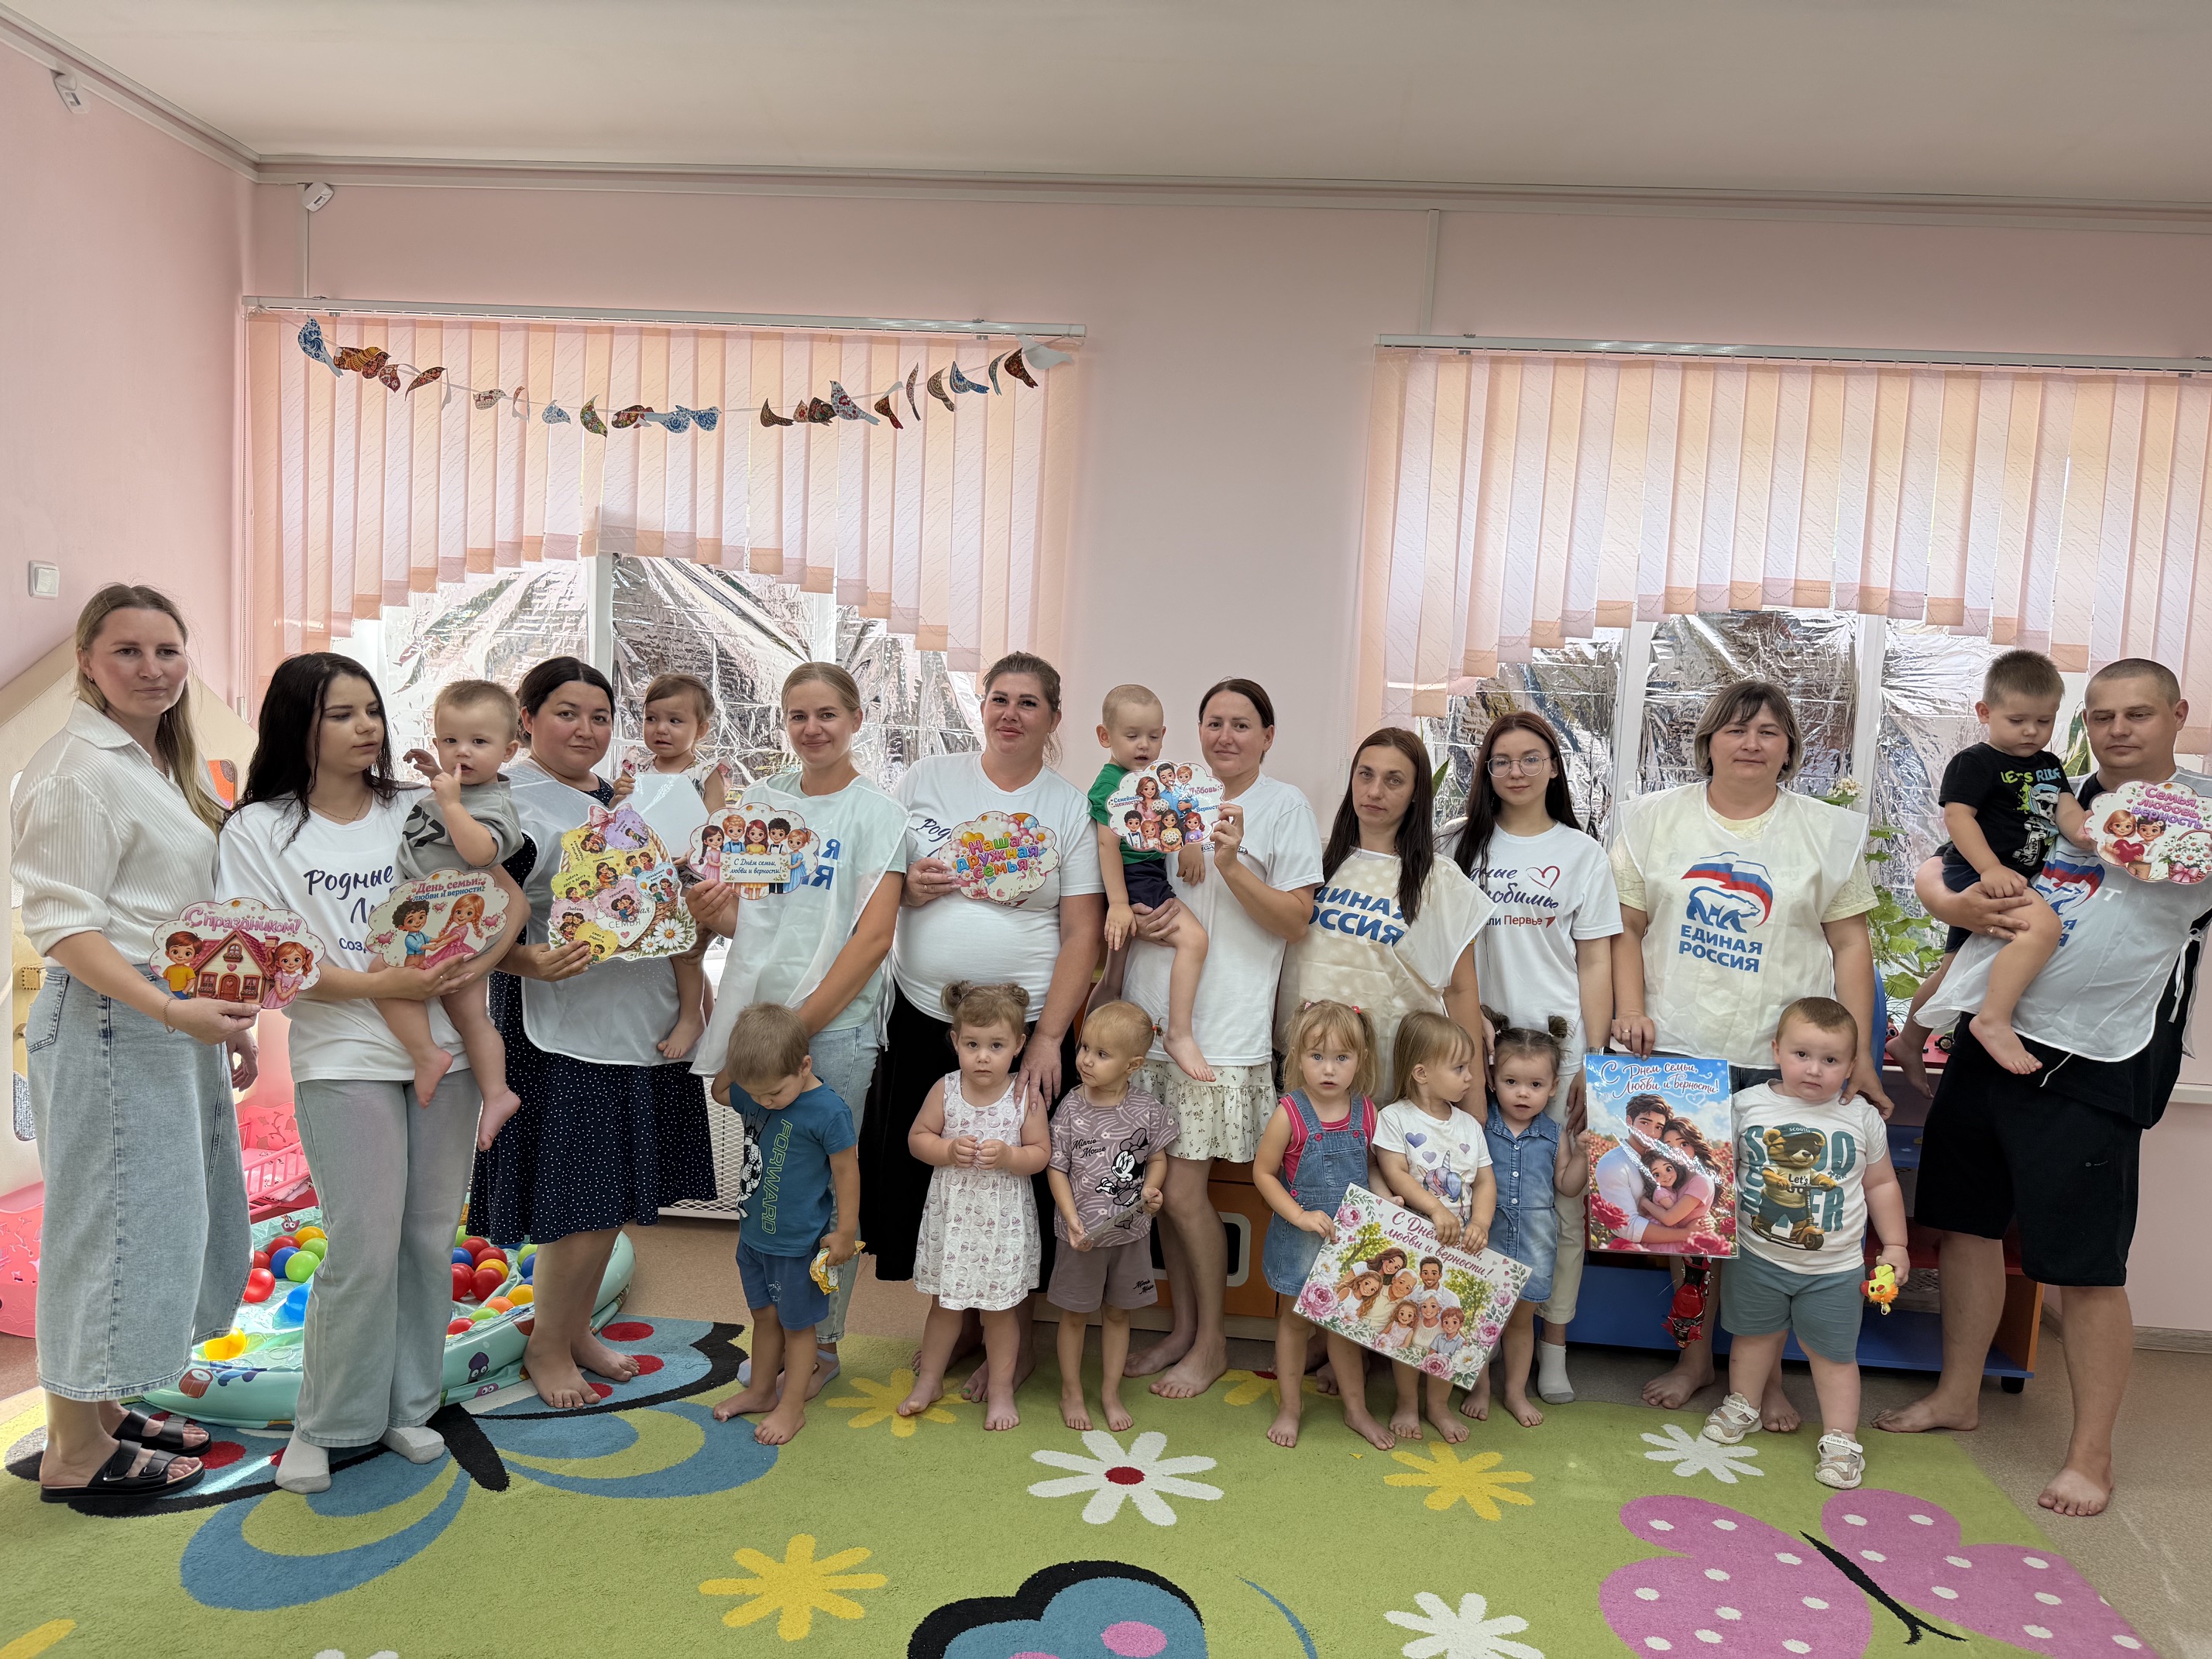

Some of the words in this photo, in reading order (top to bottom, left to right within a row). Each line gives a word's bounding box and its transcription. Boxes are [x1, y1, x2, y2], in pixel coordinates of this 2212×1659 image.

[2145, 786, 2199, 809] Семья,
[2131, 805, 2203, 830] верность
[969, 836, 1021, 855] Наша
[956, 846, 1039, 874] дружная
[973, 858, 1029, 880] семья
[303, 865, 393, 901] Родные
[415, 882, 445, 895] День
[413, 892, 439, 902] любви
[203, 912, 304, 935] праздником!
[1680, 924, 1763, 955] ЕДИНАЯ
[1678, 940, 1760, 973] РОССИЯ
[1600, 1060, 1620, 1084] С
[1623, 1063, 1661, 1080] Днем
[1664, 1062, 1698, 1073] семьи,
[1613, 1076, 1661, 1098] Любви
[1071, 1137, 1097, 1152] Minnie
[1080, 1146, 1107, 1159] Mouse
[761, 1118, 794, 1235] FORWARD
[1788, 1173, 1809, 1186] Let's
[1392, 1211, 1406, 1225] С
[1383, 1228, 1423, 1250] любви
[1424, 1245, 1433, 1254] и
[1434, 1245, 1495, 1279] верности!
